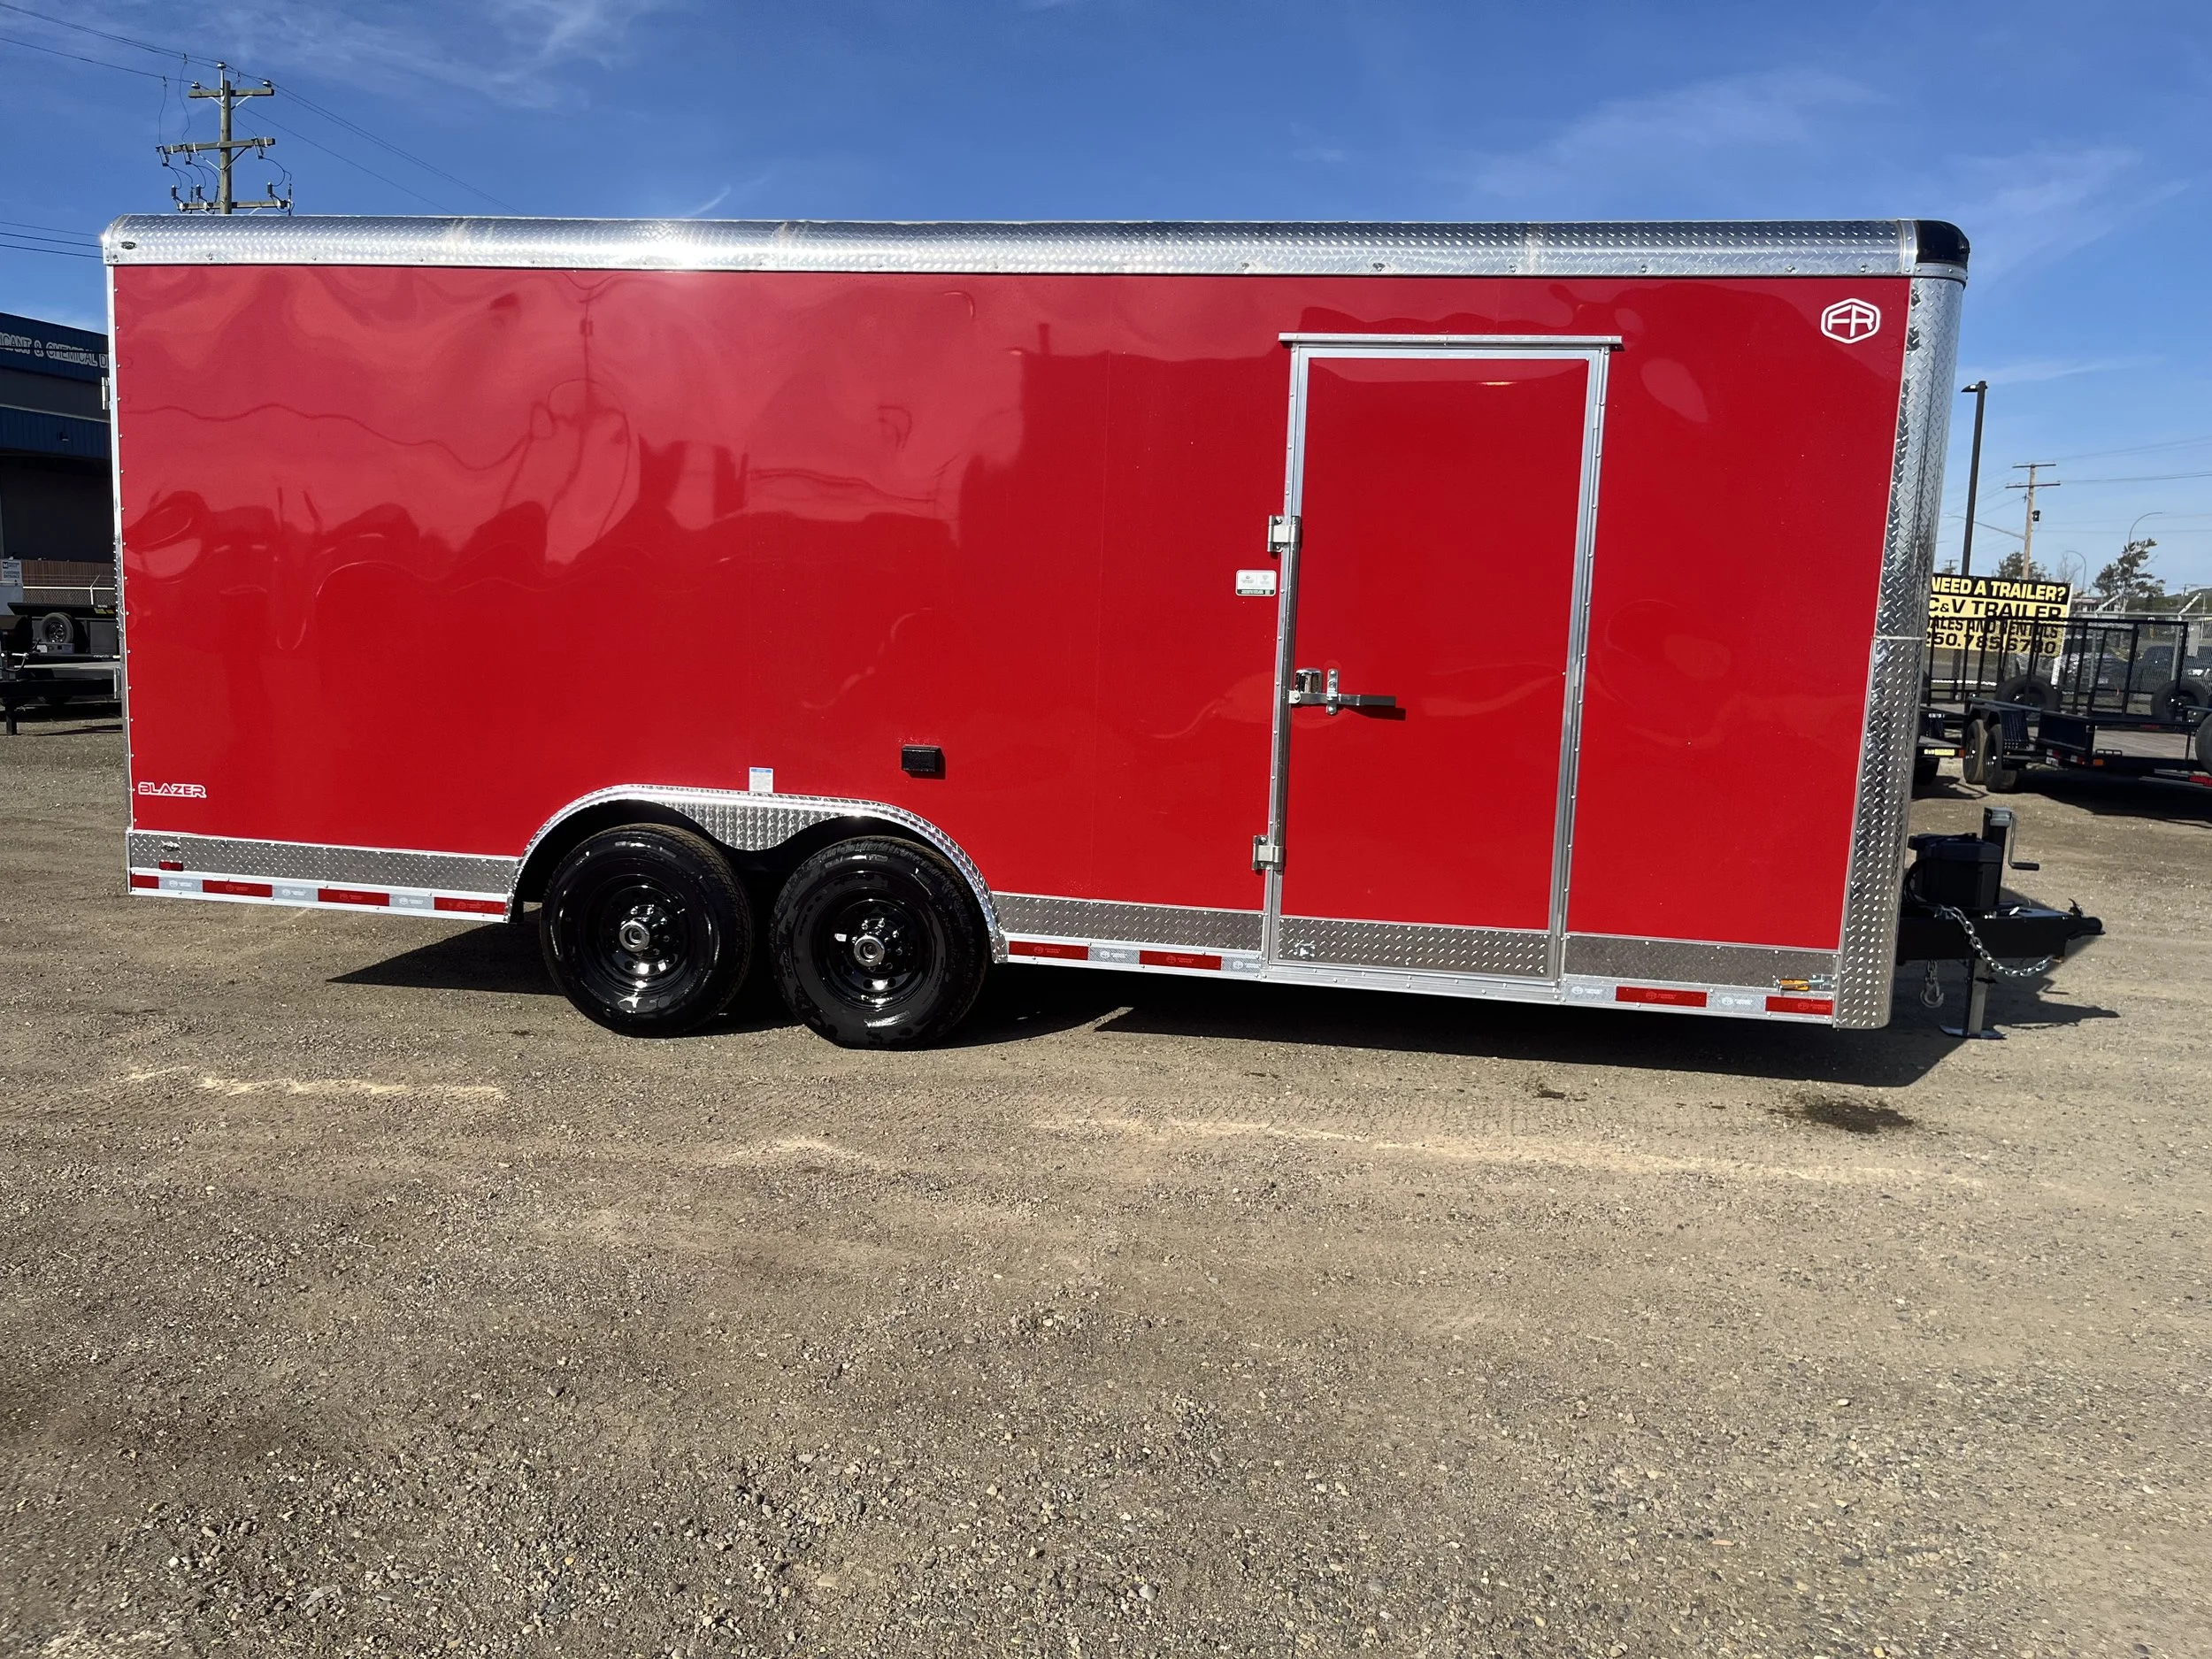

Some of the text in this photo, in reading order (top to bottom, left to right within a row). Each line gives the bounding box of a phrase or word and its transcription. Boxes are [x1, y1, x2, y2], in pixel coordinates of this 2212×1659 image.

[34, 340, 44, 357] &
[46, 342, 98, 367] CHEMICAL
[1932, 576, 2067, 603] NEED A TRAILER?
[1970, 600, 2062, 620] TRAILER
[1927, 616, 1964, 632] ALES
[2001, 619, 2059, 639] ENTLS
[138, 782, 207, 798] BLAZER
